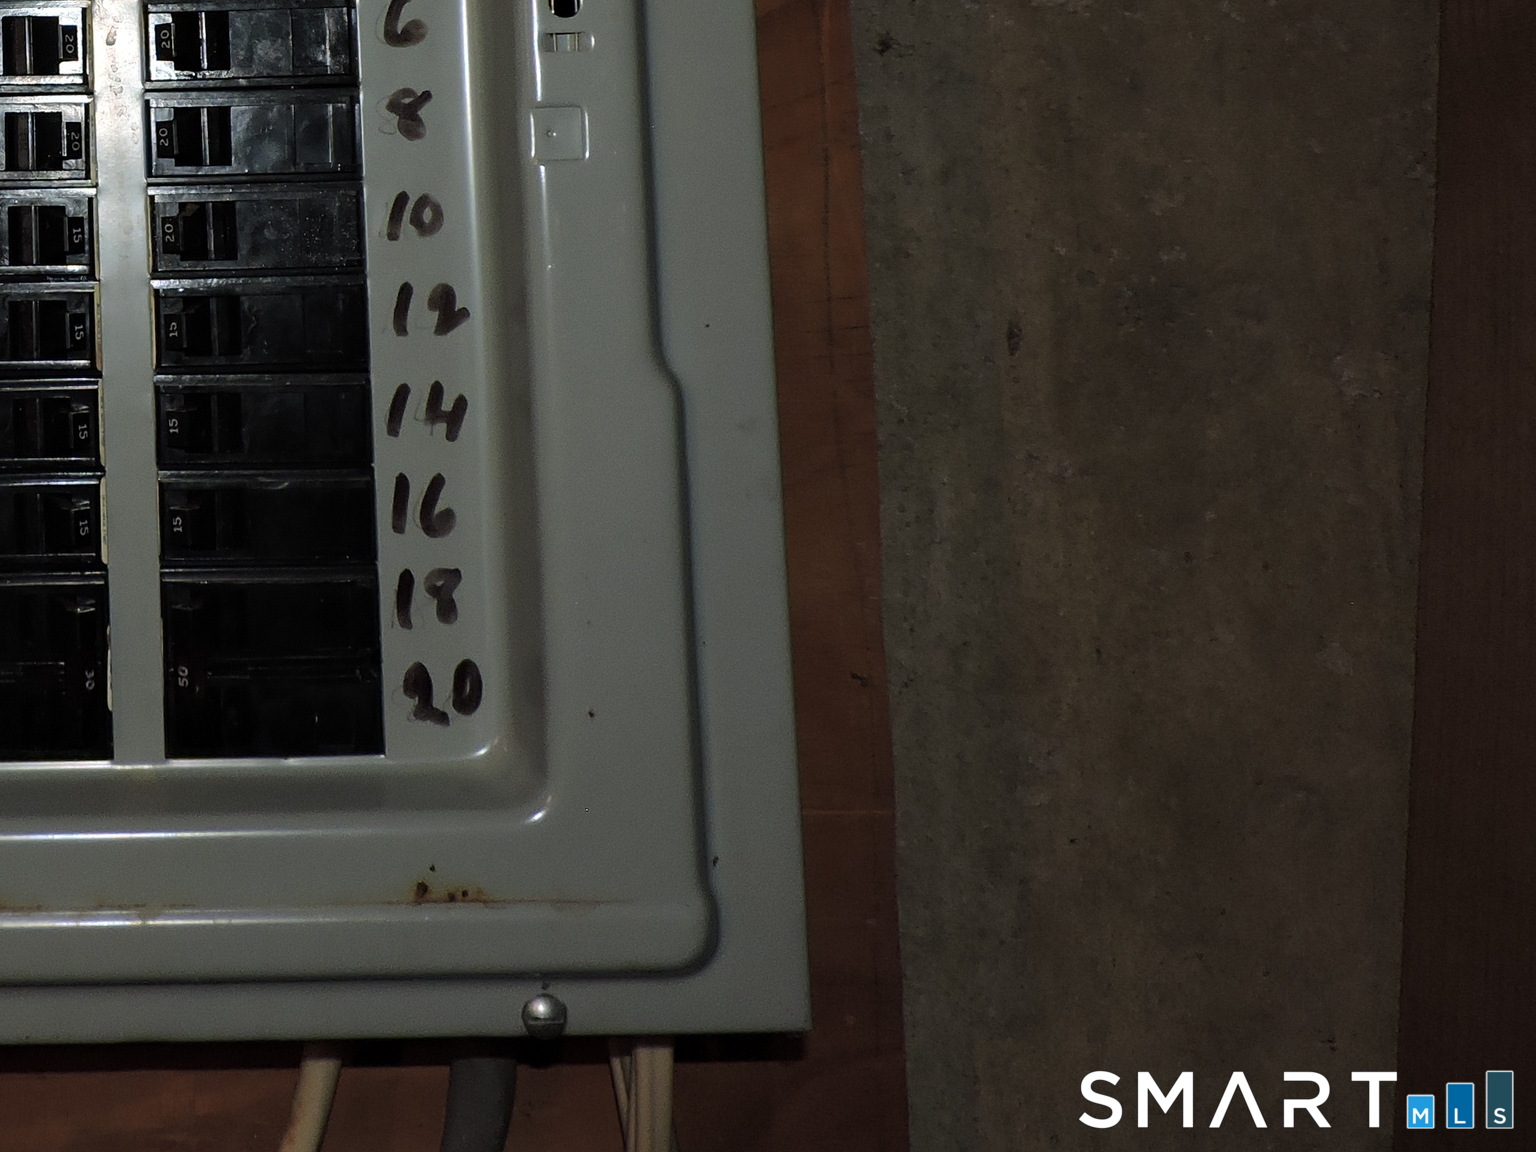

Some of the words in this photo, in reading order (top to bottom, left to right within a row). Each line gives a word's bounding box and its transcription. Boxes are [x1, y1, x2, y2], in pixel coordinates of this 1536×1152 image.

[65, 34, 74, 53] 20
[161, 30, 170, 48] 20
[386, 88, 432, 141] 8
[71, 132, 80, 151] 20
[159, 128, 168, 146] 20
[387, 191, 443, 241] 10
[73, 227, 82, 243] 15
[165, 223, 175, 242] 20
[393, 282, 470, 336] 12
[75, 324, 84, 340] 15
[387, 380, 468, 442] 14
[78, 424, 88, 439] 15
[169, 418, 178, 434] 15
[392, 472, 455, 538] 16
[80, 520, 89, 536] 15
[173, 517, 182, 532] 15
[396, 568, 462, 629] 18
[85, 670, 94, 690] 30
[179, 666, 188, 687] 50
[403, 659, 483, 726] 20
